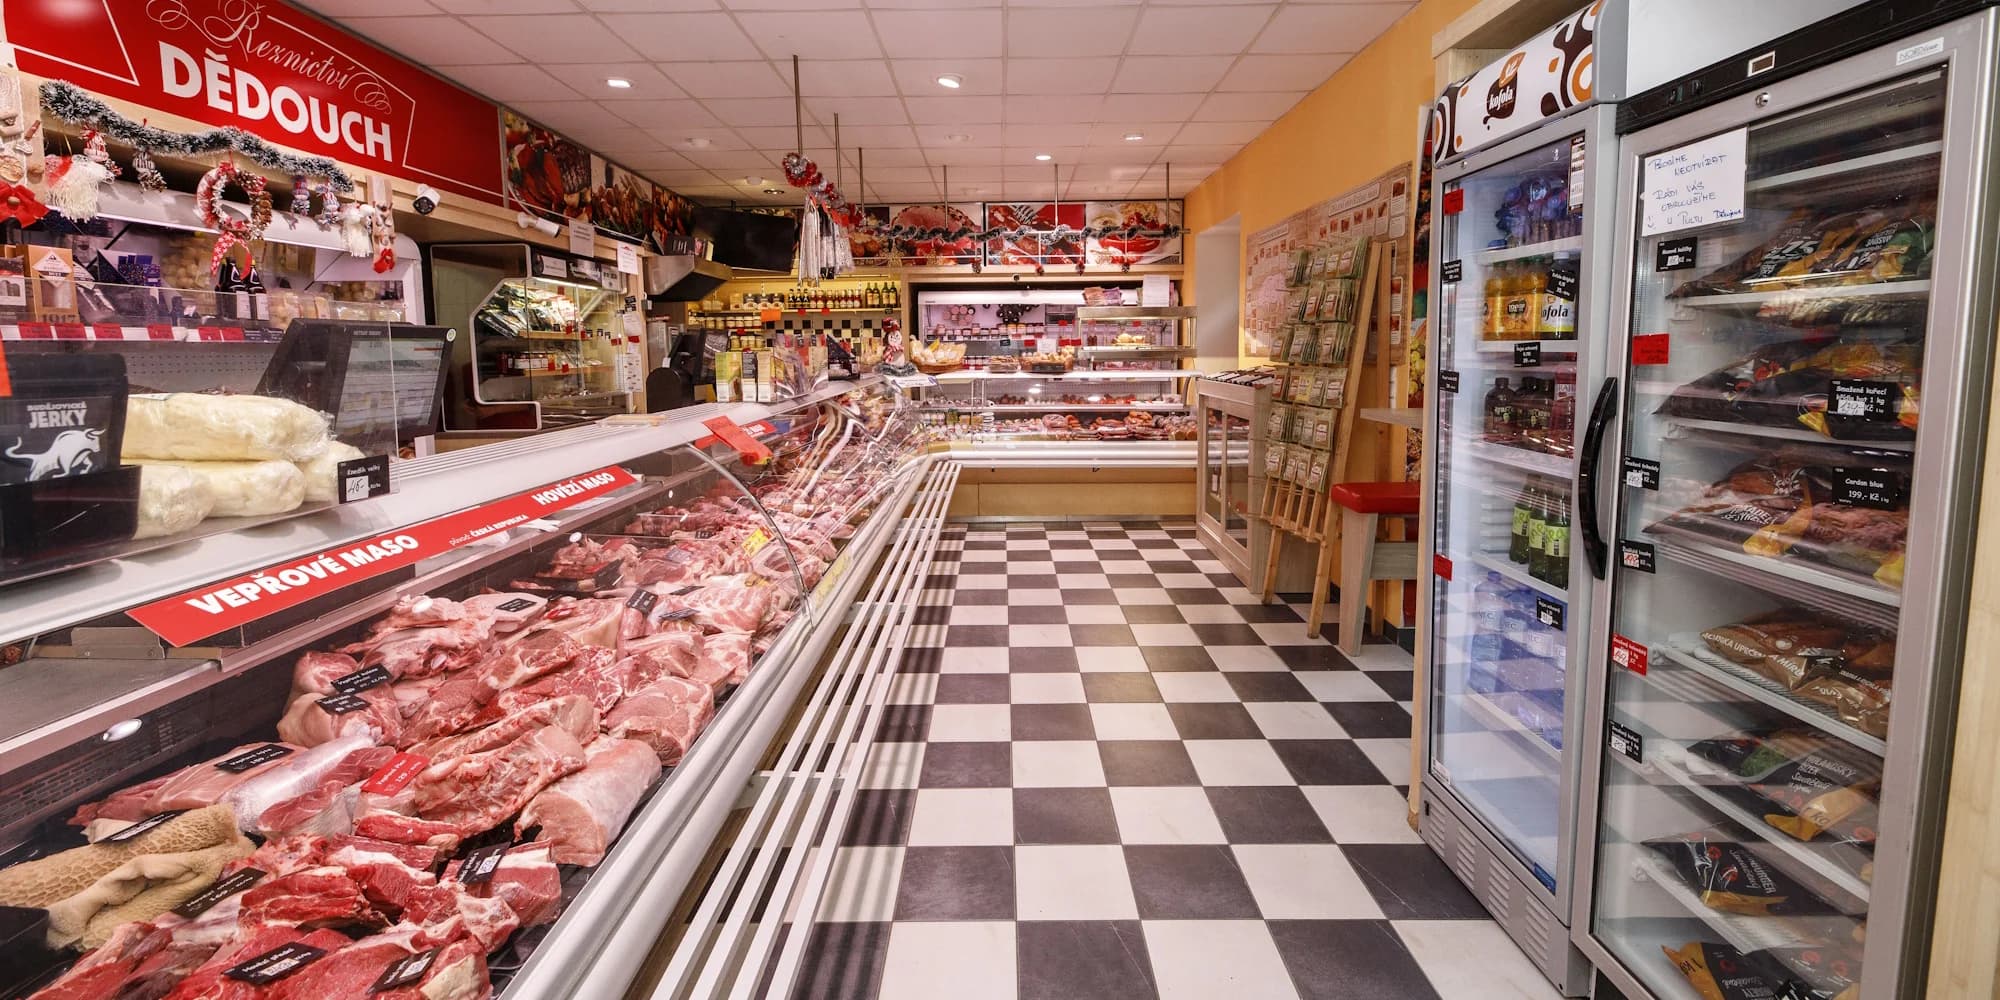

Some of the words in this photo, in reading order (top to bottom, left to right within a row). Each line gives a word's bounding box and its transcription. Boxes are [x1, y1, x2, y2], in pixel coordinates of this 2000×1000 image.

[158, 41, 393, 162] DĚDOUCH
[1543, 304, 1569, 320] ofola
[29, 409, 88, 429] JERKY
[531, 480, 584, 506] HOVĚZÍ
[578, 472, 616, 490] MASO
[1849, 490, 1868, 500] 199,-
[185, 555, 347, 614] VEPŘOVÉ
[340, 535, 419, 567] MASO
